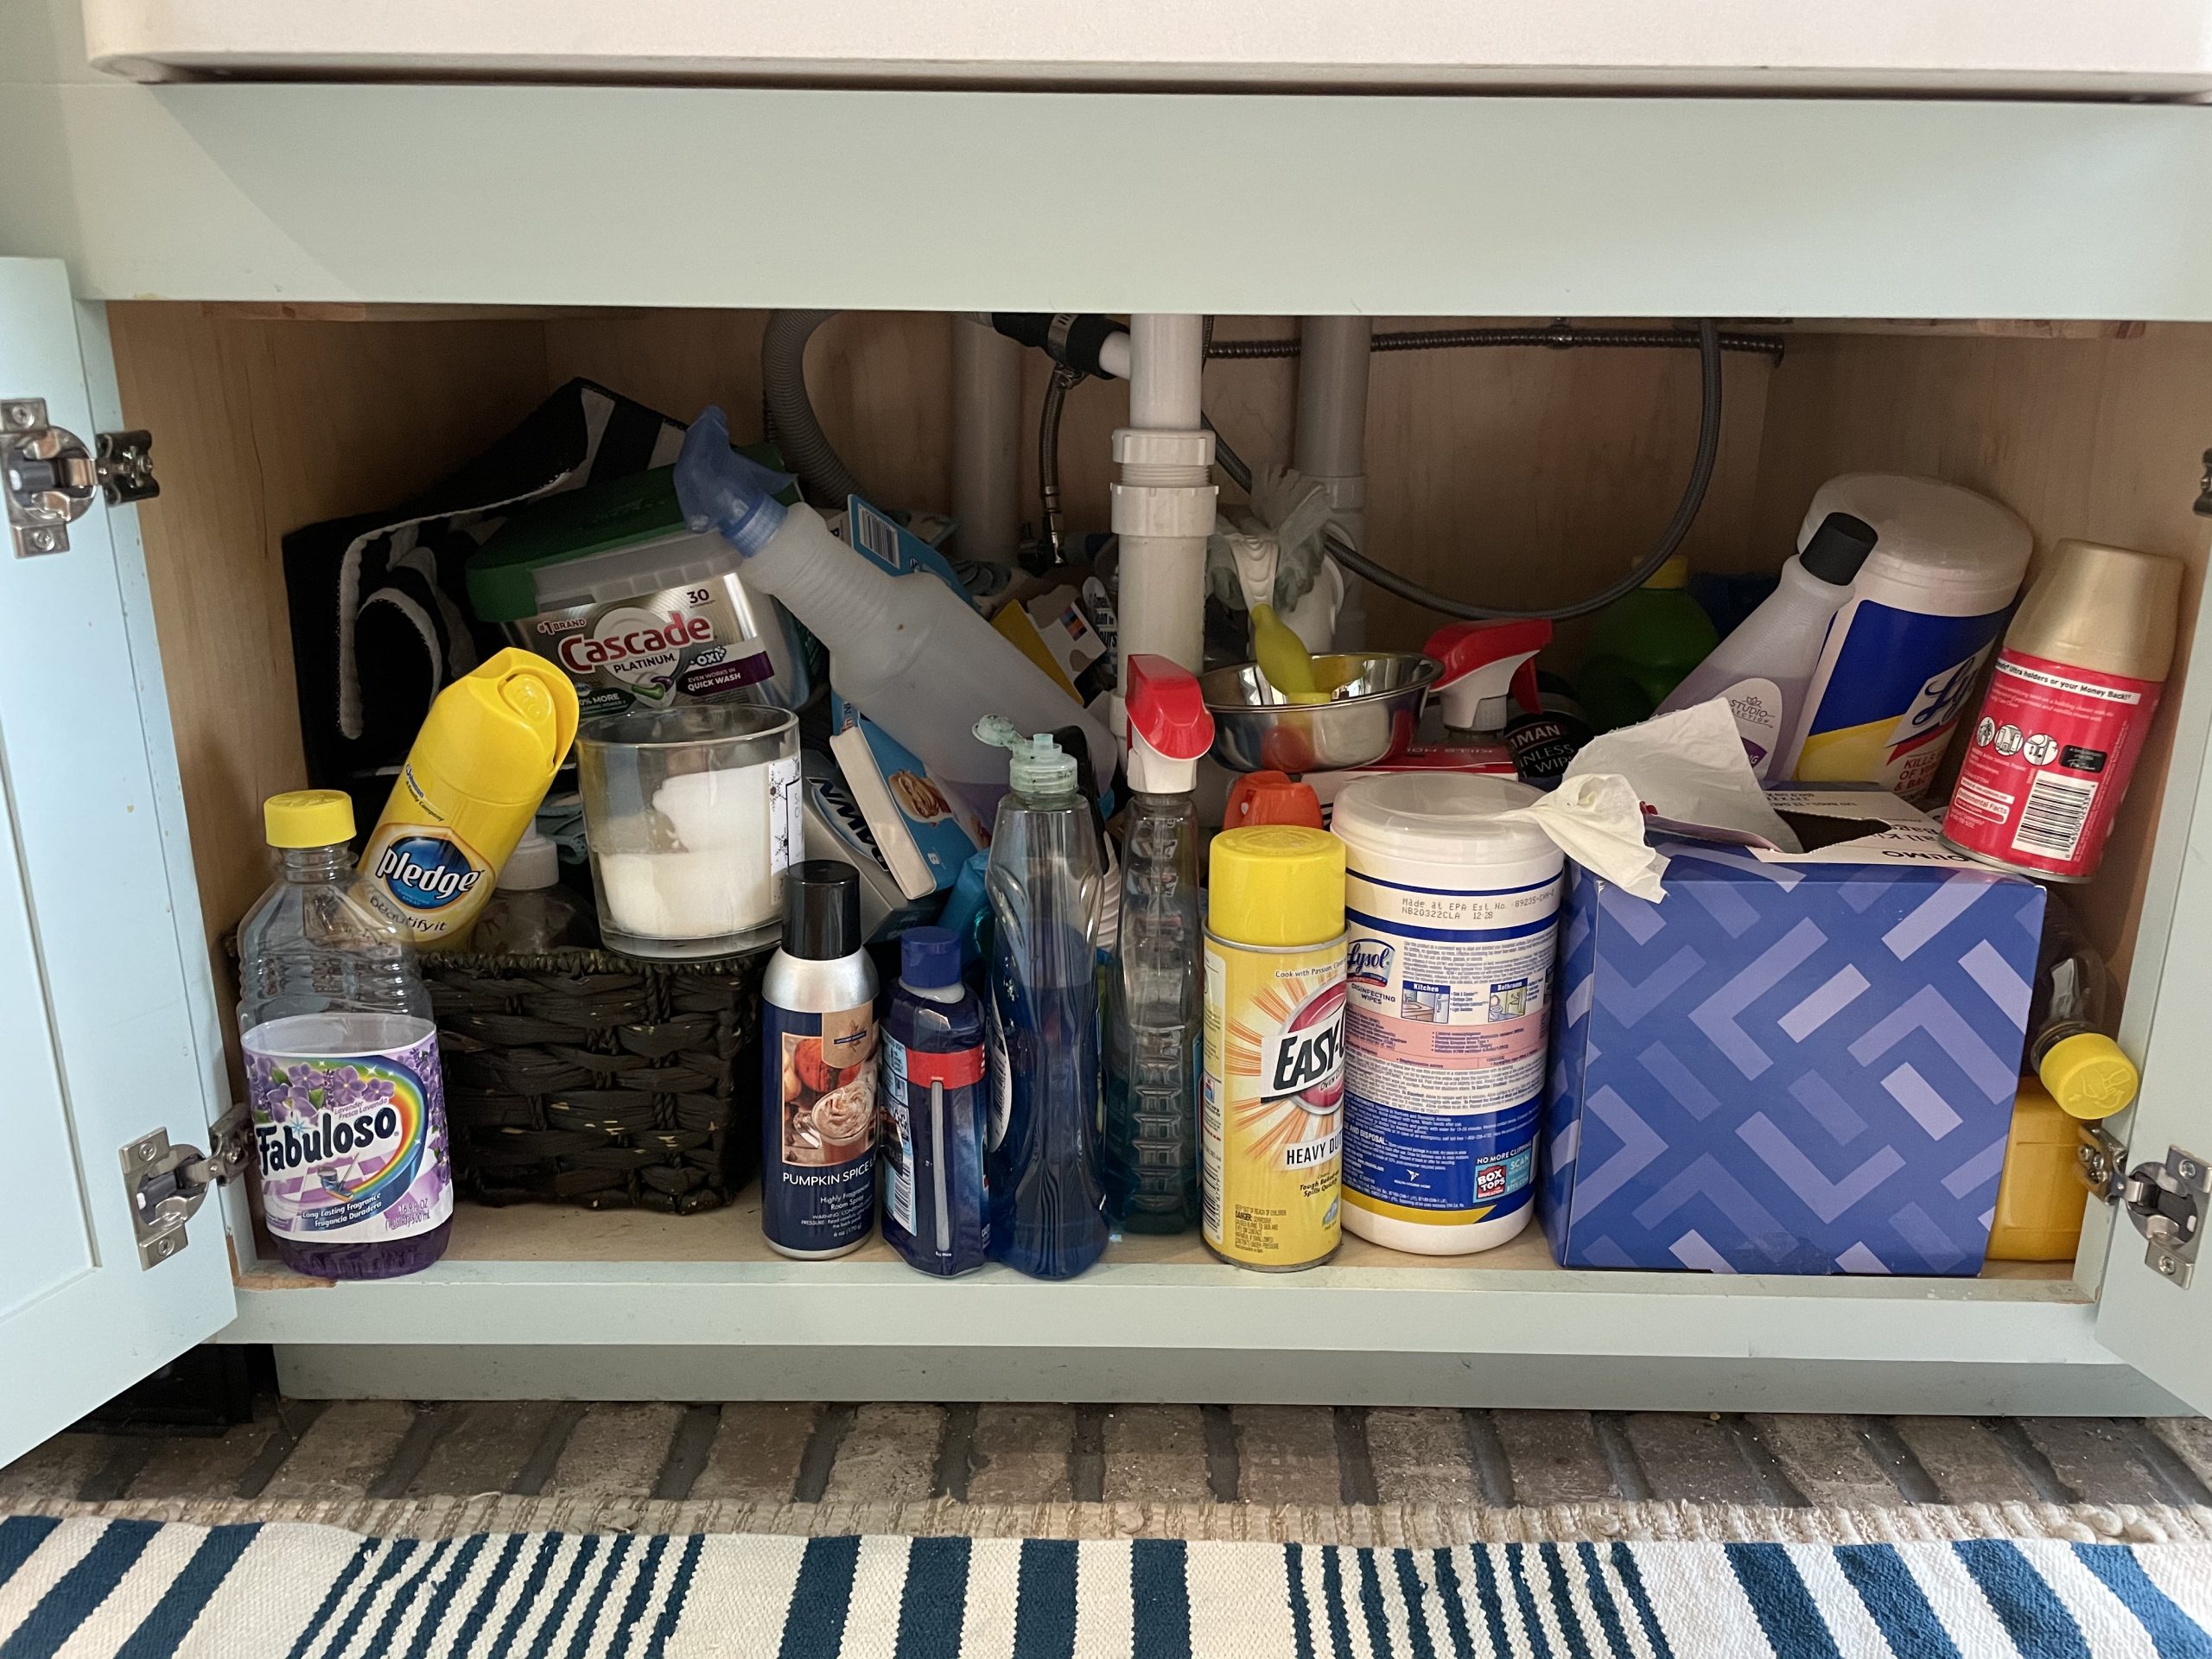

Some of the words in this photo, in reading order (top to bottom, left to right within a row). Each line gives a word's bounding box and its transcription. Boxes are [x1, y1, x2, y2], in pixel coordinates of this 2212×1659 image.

[687, 588, 709, 604] 30
[554, 617, 587, 632] BRAND
[560, 611, 712, 672] Cascade
[613, 653, 675, 673] PLATINUM
[697, 651, 721, 666] OXI
[688, 673, 704, 683] EVEN
[704, 670, 728, 680] WORKS
[688, 677, 716, 691] QUICK
[716, 672, 741, 687] WASH
[2009, 665, 2023, 676] Ultra
[2023, 670, 2049, 683] holders
[2060, 679, 2078, 690] your
[2080, 683, 2106, 697] Money
[593, 692, 620, 704] MORE
[1730, 700, 1768, 717] STUDIO
[1732, 709, 1770, 723] LECTION
[1510, 724, 1561, 749] IMAN
[1904, 753, 1936, 769] KILLS
[1899, 769, 1918, 780] OF
[419, 801, 445, 822] Company
[1989, 803, 2007, 815] Facts
[375, 845, 482, 899] pledge
[1402, 897, 1426, 907] Made
[1431, 901, 1443, 910] at
[1449, 902, 1467, 911] EPA
[1402, 906, 1461, 919] NB20322CLA
[1348, 943, 1390, 976] Lysol
[1351, 982, 1396, 1002] DISINFECTING
[1413, 982, 1440, 993] Kitchen
[1497, 981, 1523, 992] Bathroom
[1361, 993, 1382, 1005] WIPES
[334, 1100, 364, 1116] Lavender
[339, 1109, 359, 1121] Fresca
[359, 1097, 388, 1115] Lavanda
[1349, 1126, 1360, 1138] AND
[256, 1107, 397, 1176] Fabuloso
[1286, 1142, 1326, 1166] HEAVY
[1477, 1156, 1489, 1165] NO
[1489, 1151, 1510, 1163] MORE
[1510, 1154, 1529, 1170] SCAN
[783, 1172, 841, 1186] PUMPKIN
[842, 1160, 869, 1183] SPICE
[1478, 1168, 1503, 1186] BOX
[1300, 1180, 1319, 1192] Tough
[1303, 1186, 1320, 1198] Spills
[1480, 1177, 1506, 1192] TOPS
[302, 1210, 320, 1219] Long
[321, 1205, 346, 1218] Lasting
[346, 1192, 381, 1211] Fragrance
[420, 1198, 429, 1210] OZ
[820, 1194, 842, 1205] Highly
[830, 1202, 849, 1211] Room
[849, 1194, 865, 1205] Spray
[348, 1201, 382, 1221] Duradera
